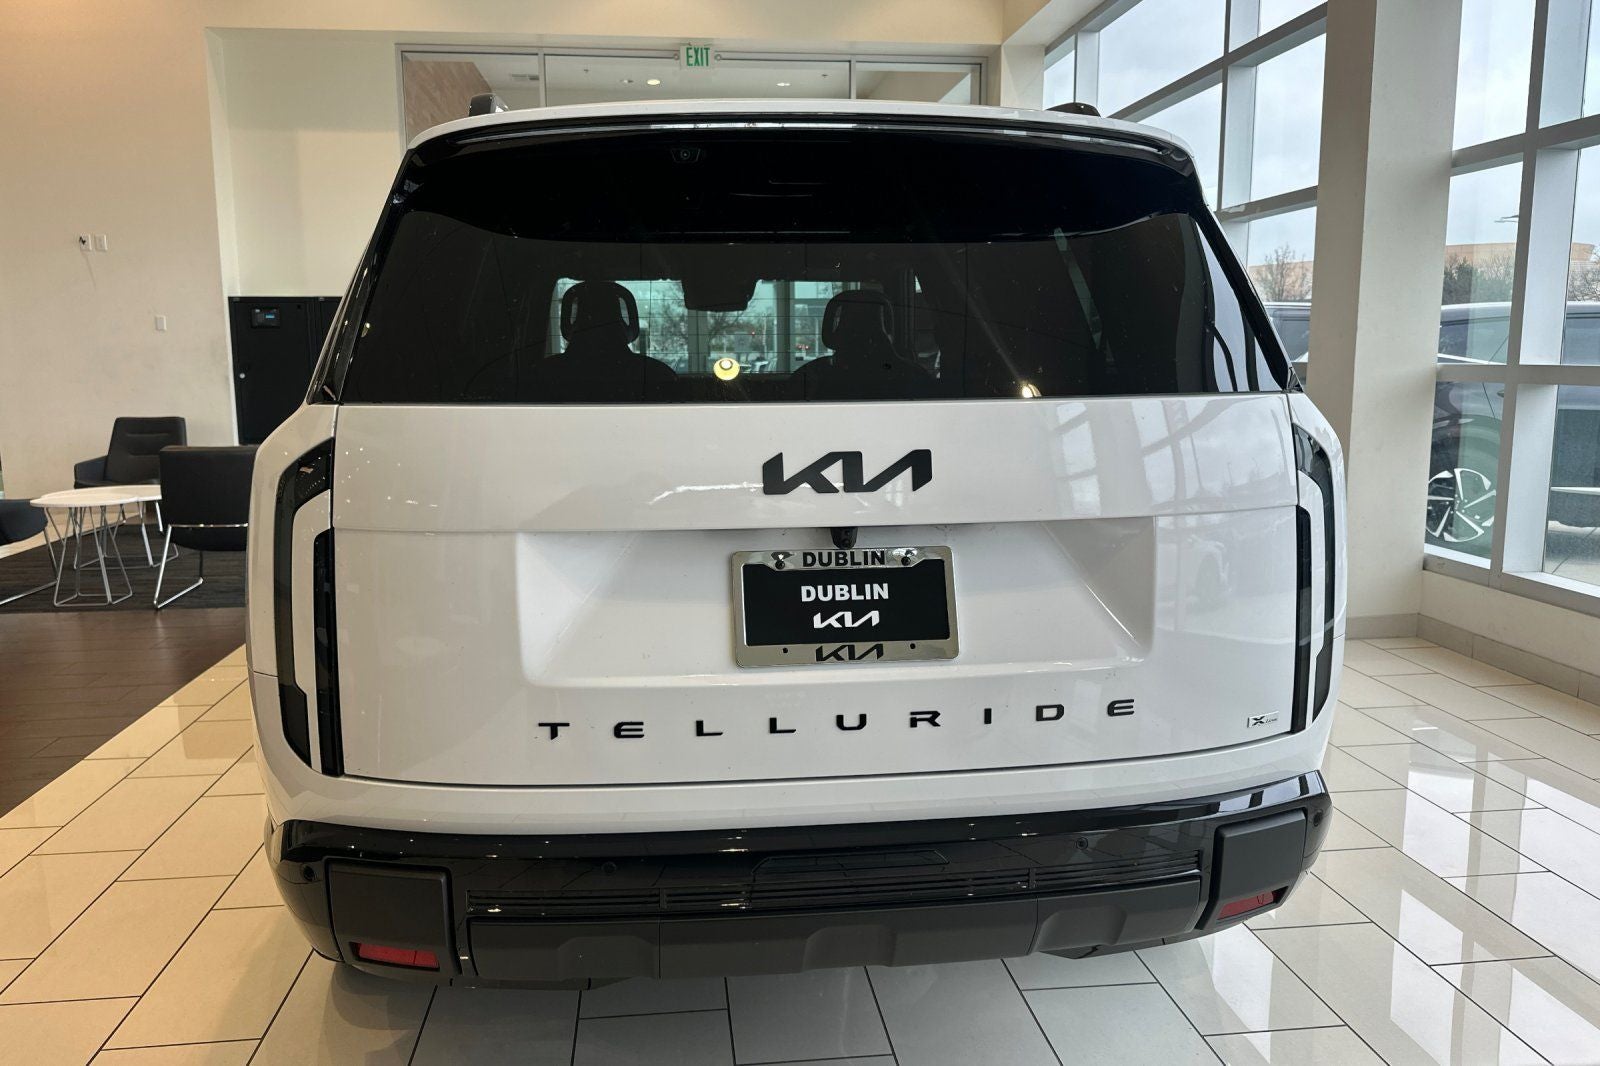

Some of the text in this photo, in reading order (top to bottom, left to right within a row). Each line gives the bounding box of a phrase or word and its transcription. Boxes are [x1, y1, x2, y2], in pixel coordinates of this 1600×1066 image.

[686, 47, 710, 67] EXIT
[802, 551, 885, 567] DUBLIN
[801, 583, 889, 602] DUBLIN
[538, 698, 1135, 740] TELLURIDE
